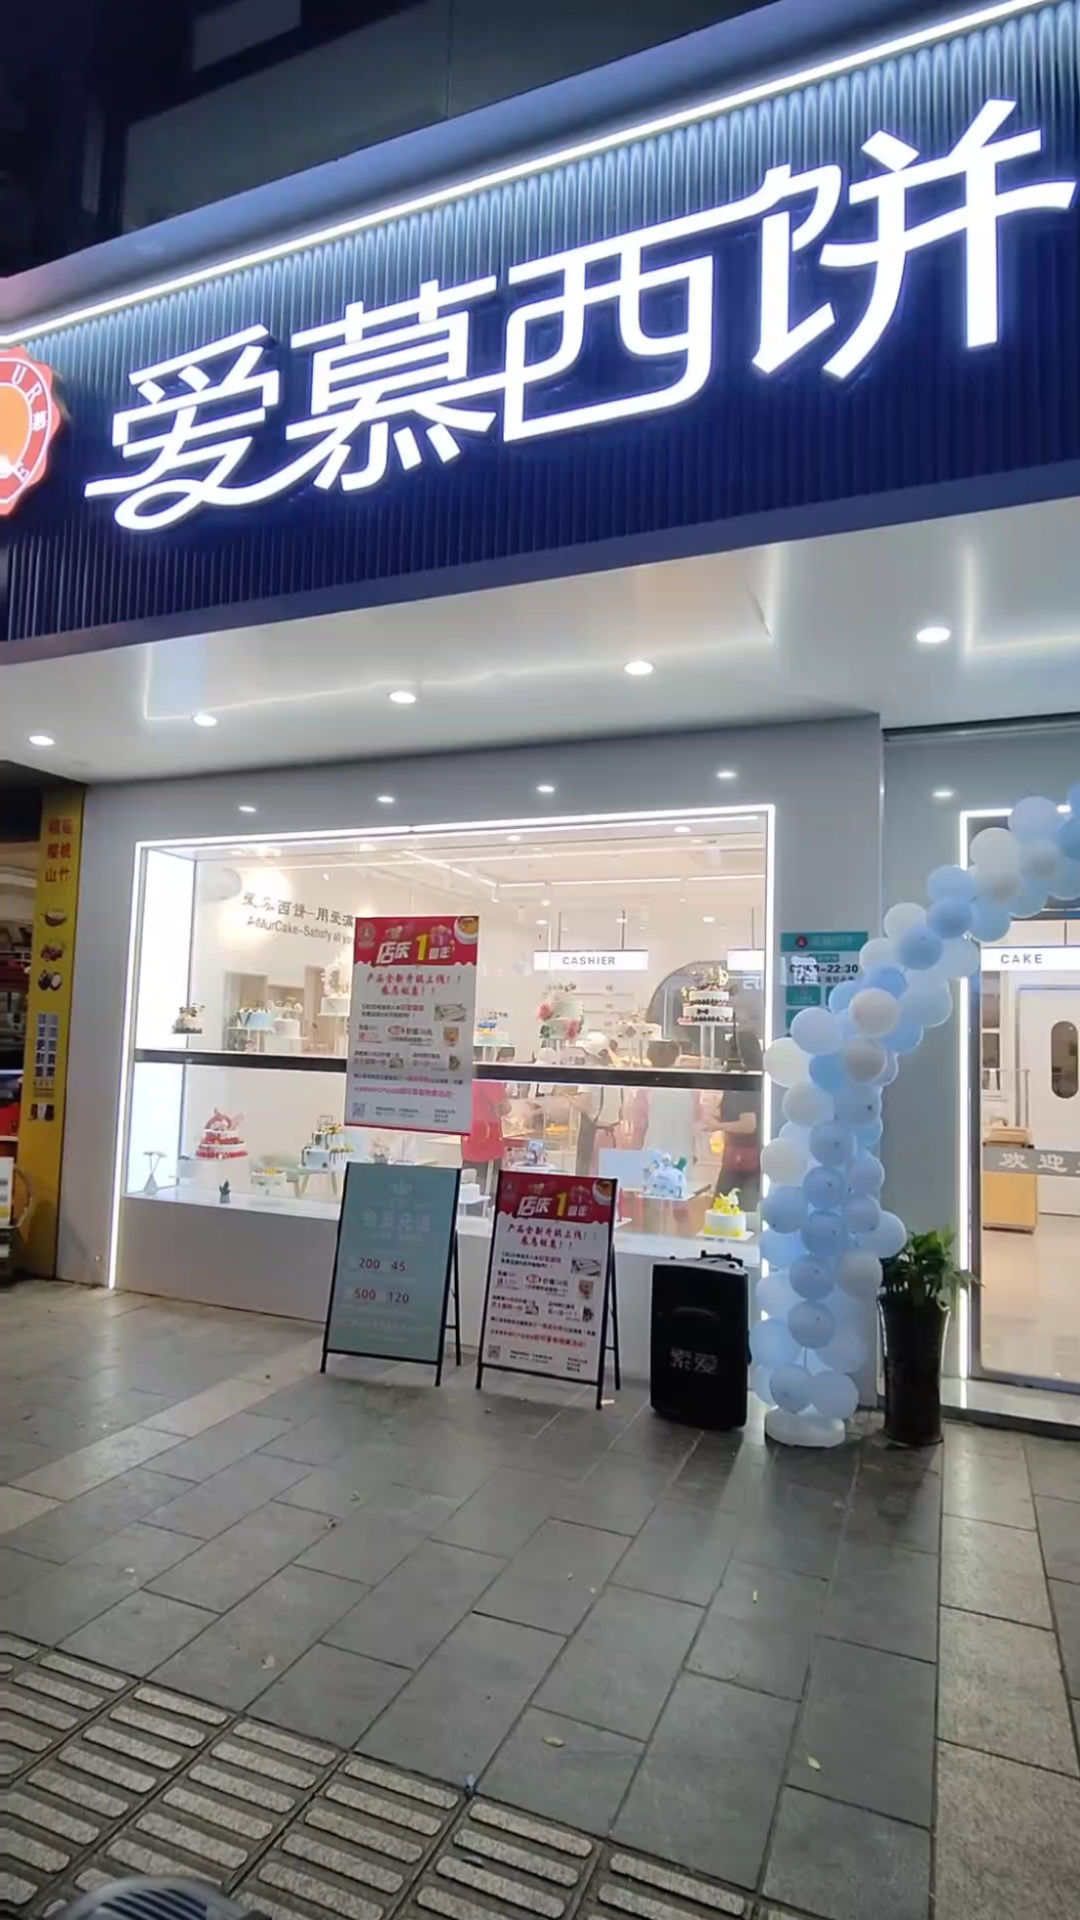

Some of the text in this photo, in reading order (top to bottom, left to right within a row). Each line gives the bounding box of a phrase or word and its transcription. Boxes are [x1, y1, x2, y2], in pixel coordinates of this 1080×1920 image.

[85, 98, 1077, 531] 爱慕西饼
[45, 867, 70, 882] 山竹
[562, 956, 616, 966] CASHIER
[1000, 953, 1043, 965] CAKE
[998, 1152, 1080, 1174] 欢迎
[358, 1257, 406, 1272] 200 45
[354, 1287, 410, 1304] 500 120
